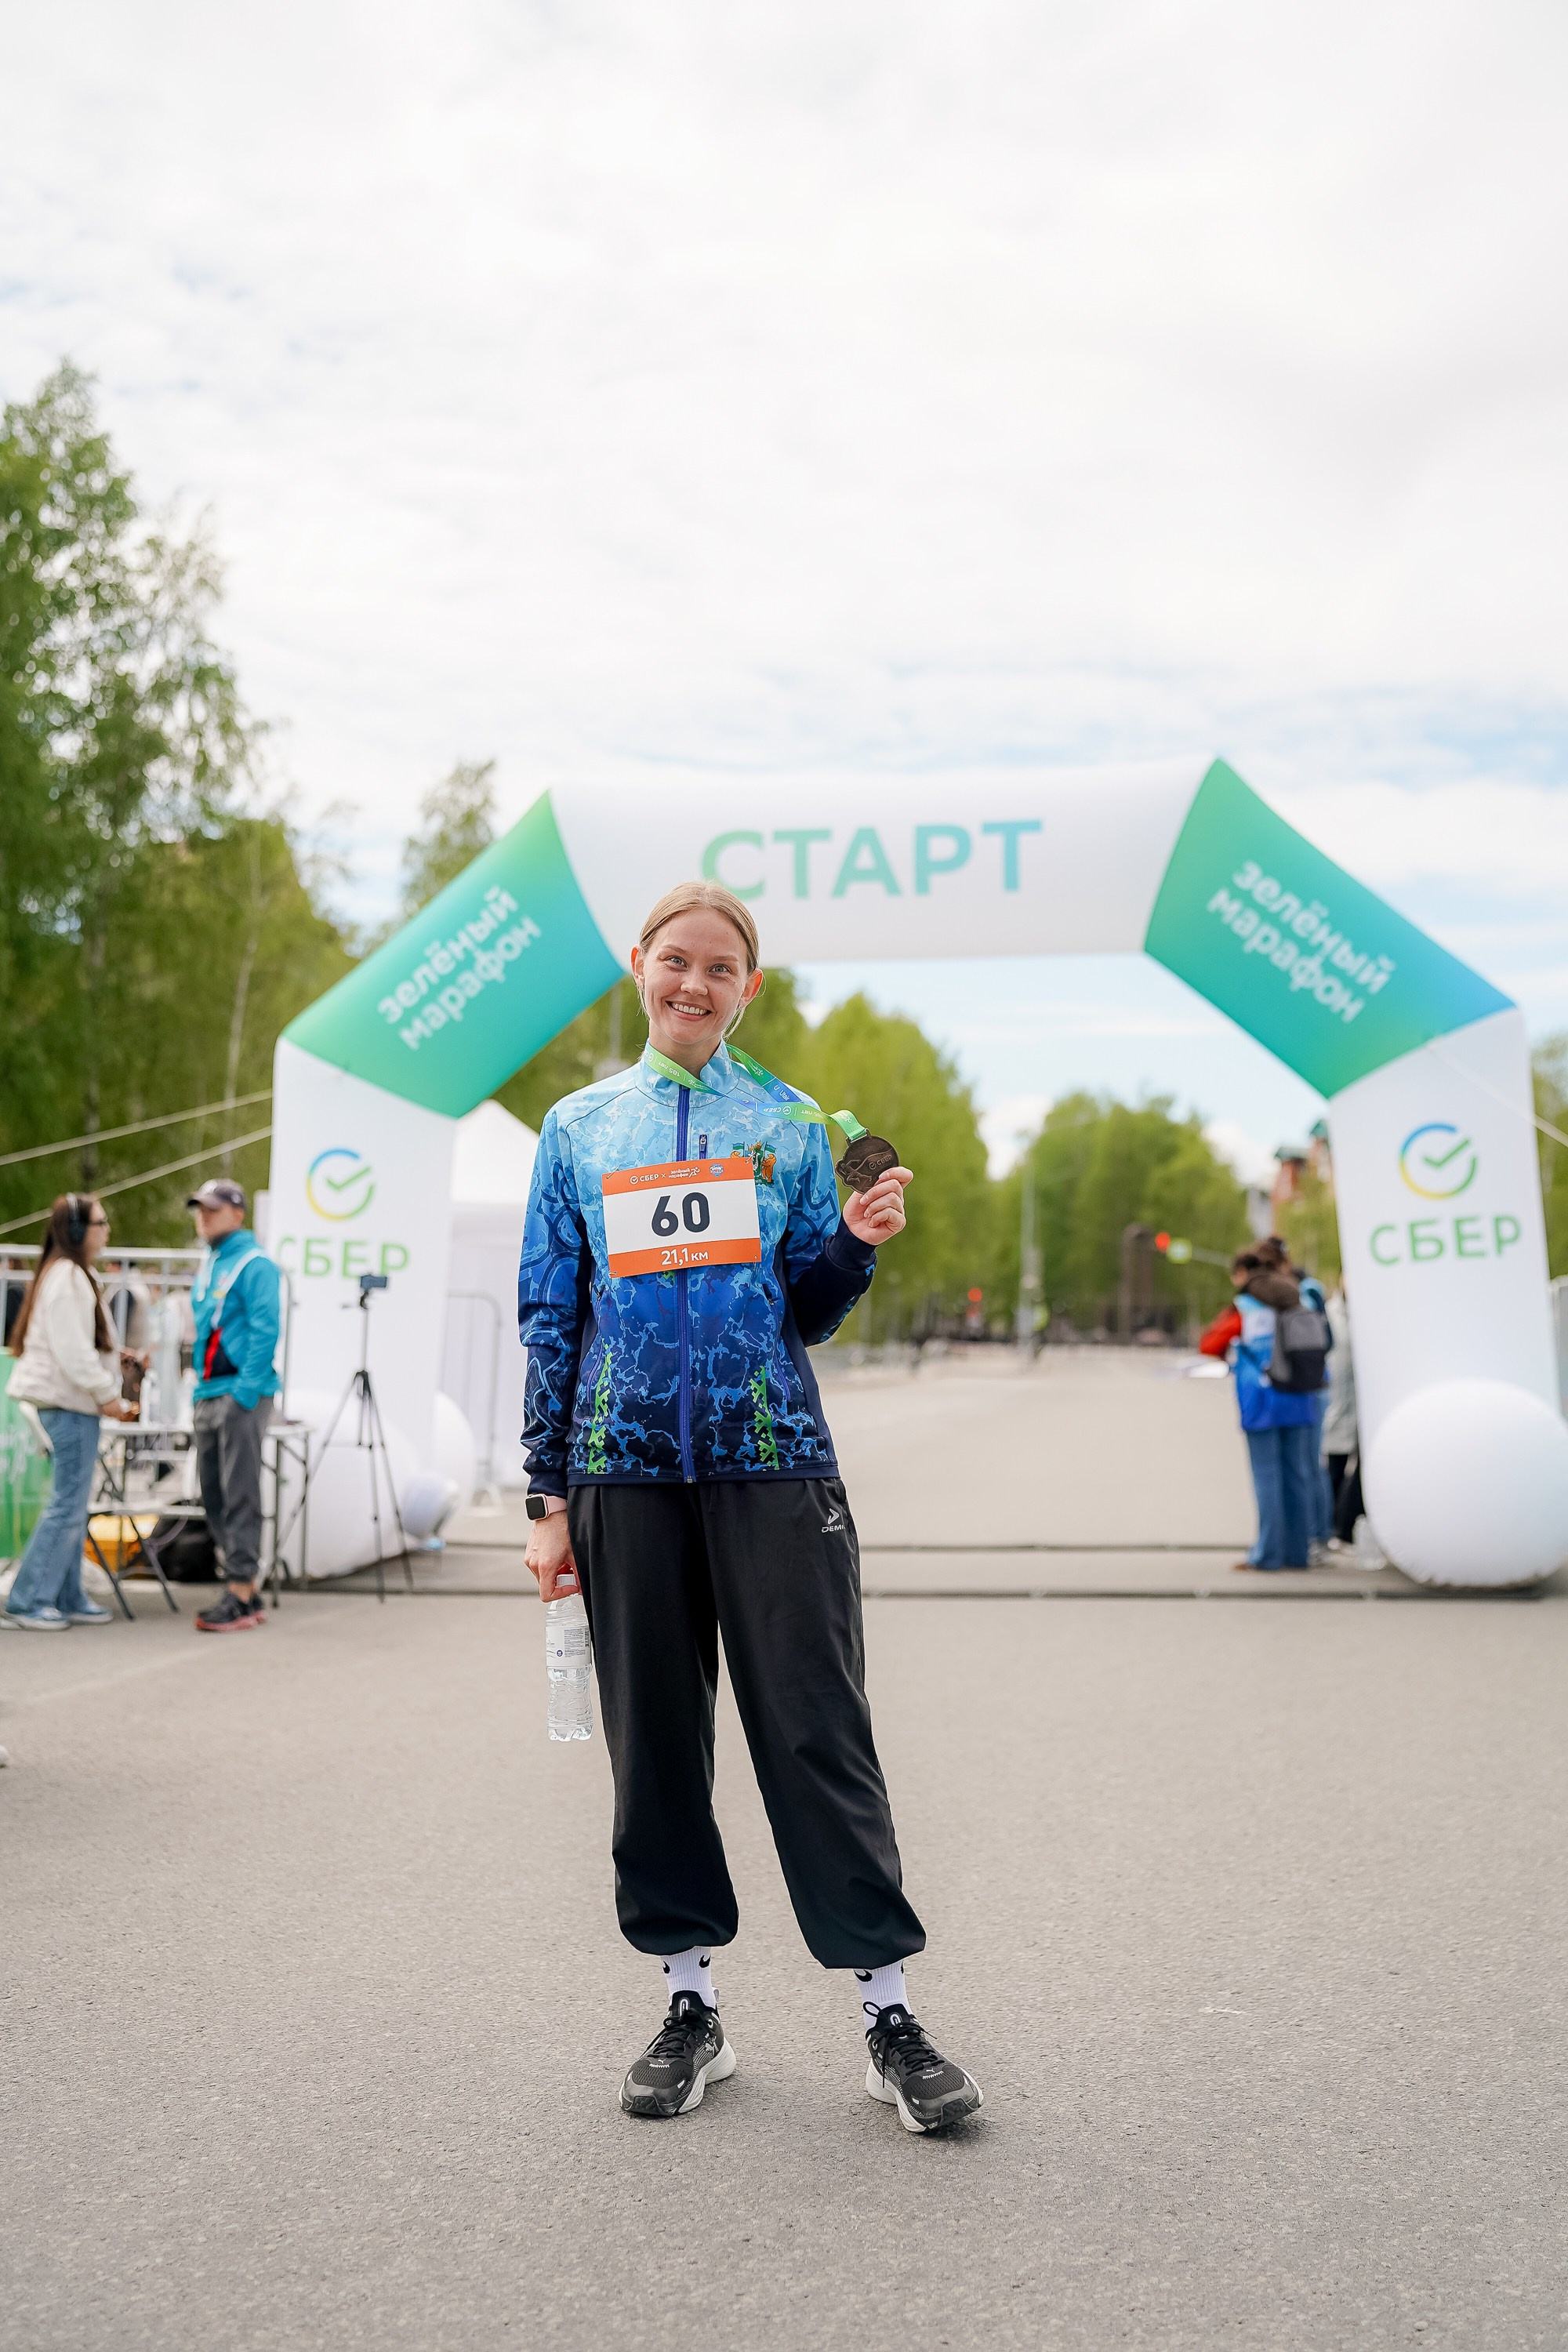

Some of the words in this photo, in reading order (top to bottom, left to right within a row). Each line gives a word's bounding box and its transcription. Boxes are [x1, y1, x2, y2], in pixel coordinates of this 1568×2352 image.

[700, 820, 1042, 902] СТАРТ
[1232, 862, 1396, 994] зелёный
[379, 885, 518, 1024] зелёный
[1208, 887, 1364, 1022] марафон
[400, 916, 541, 1050] марафон
[779, 1089, 790, 1102] Utair
[640, 1174, 659, 1182] СБЕР
[877, 1154, 892, 1165] СБЕР
[652, 1192, 710, 1236] 60
[277, 1236, 409, 1279] СБЕР
[661, 1247, 689, 1266] 21,1
[691, 1251, 709, 1261] км
[1370, 1214, 1522, 1266] СБЕР
